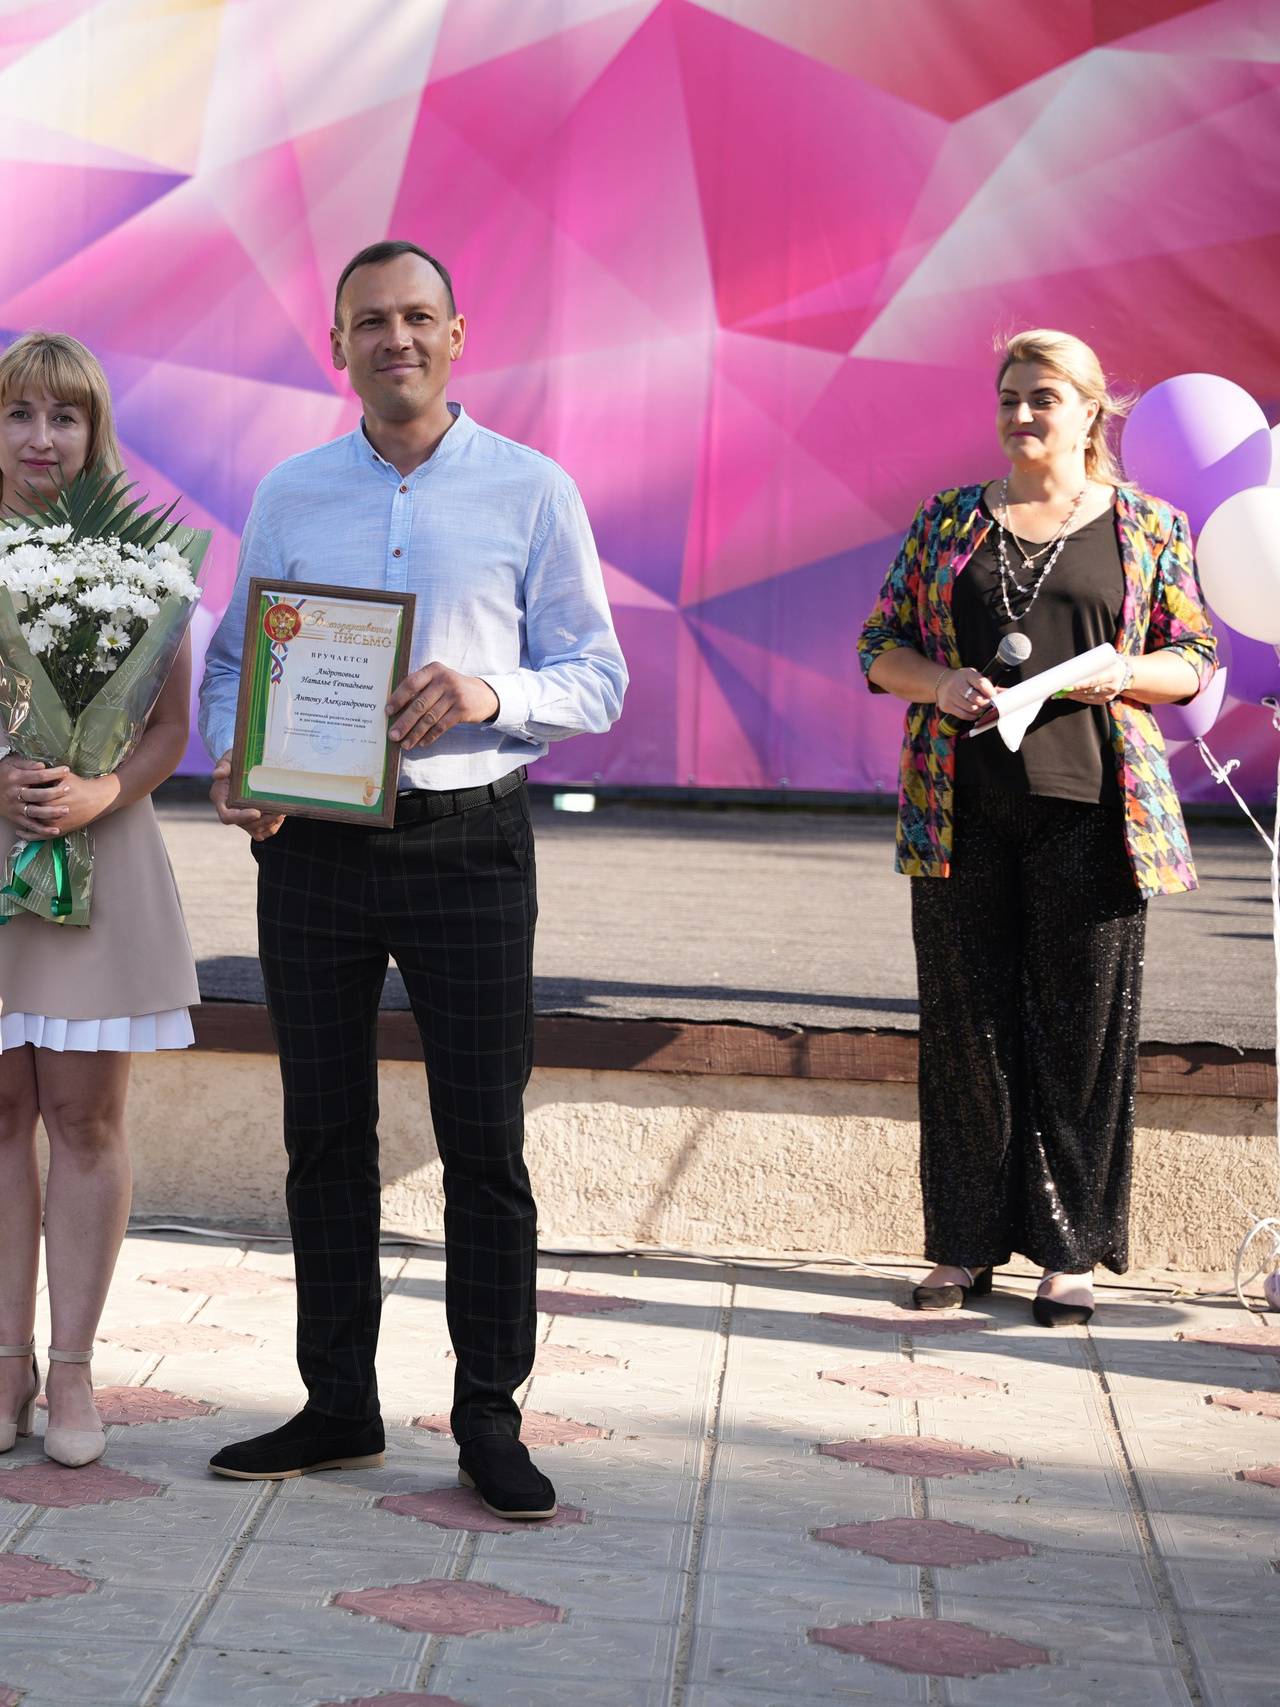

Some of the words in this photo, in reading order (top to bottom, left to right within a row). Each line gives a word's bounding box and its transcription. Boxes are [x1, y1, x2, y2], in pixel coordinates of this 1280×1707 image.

[303, 609, 393, 634] Благодарственное
[333, 631, 392, 648] ПИСЬМО
[311, 652, 369, 664] ВРУЧАЕТСЯ
[315, 668, 360, 679] Андроповым
[300, 676, 331, 687] Наталье
[332, 680, 374, 691] Геннадьевне
[293, 694, 322, 705] Антону
[322, 697, 377, 711] Александровичу
